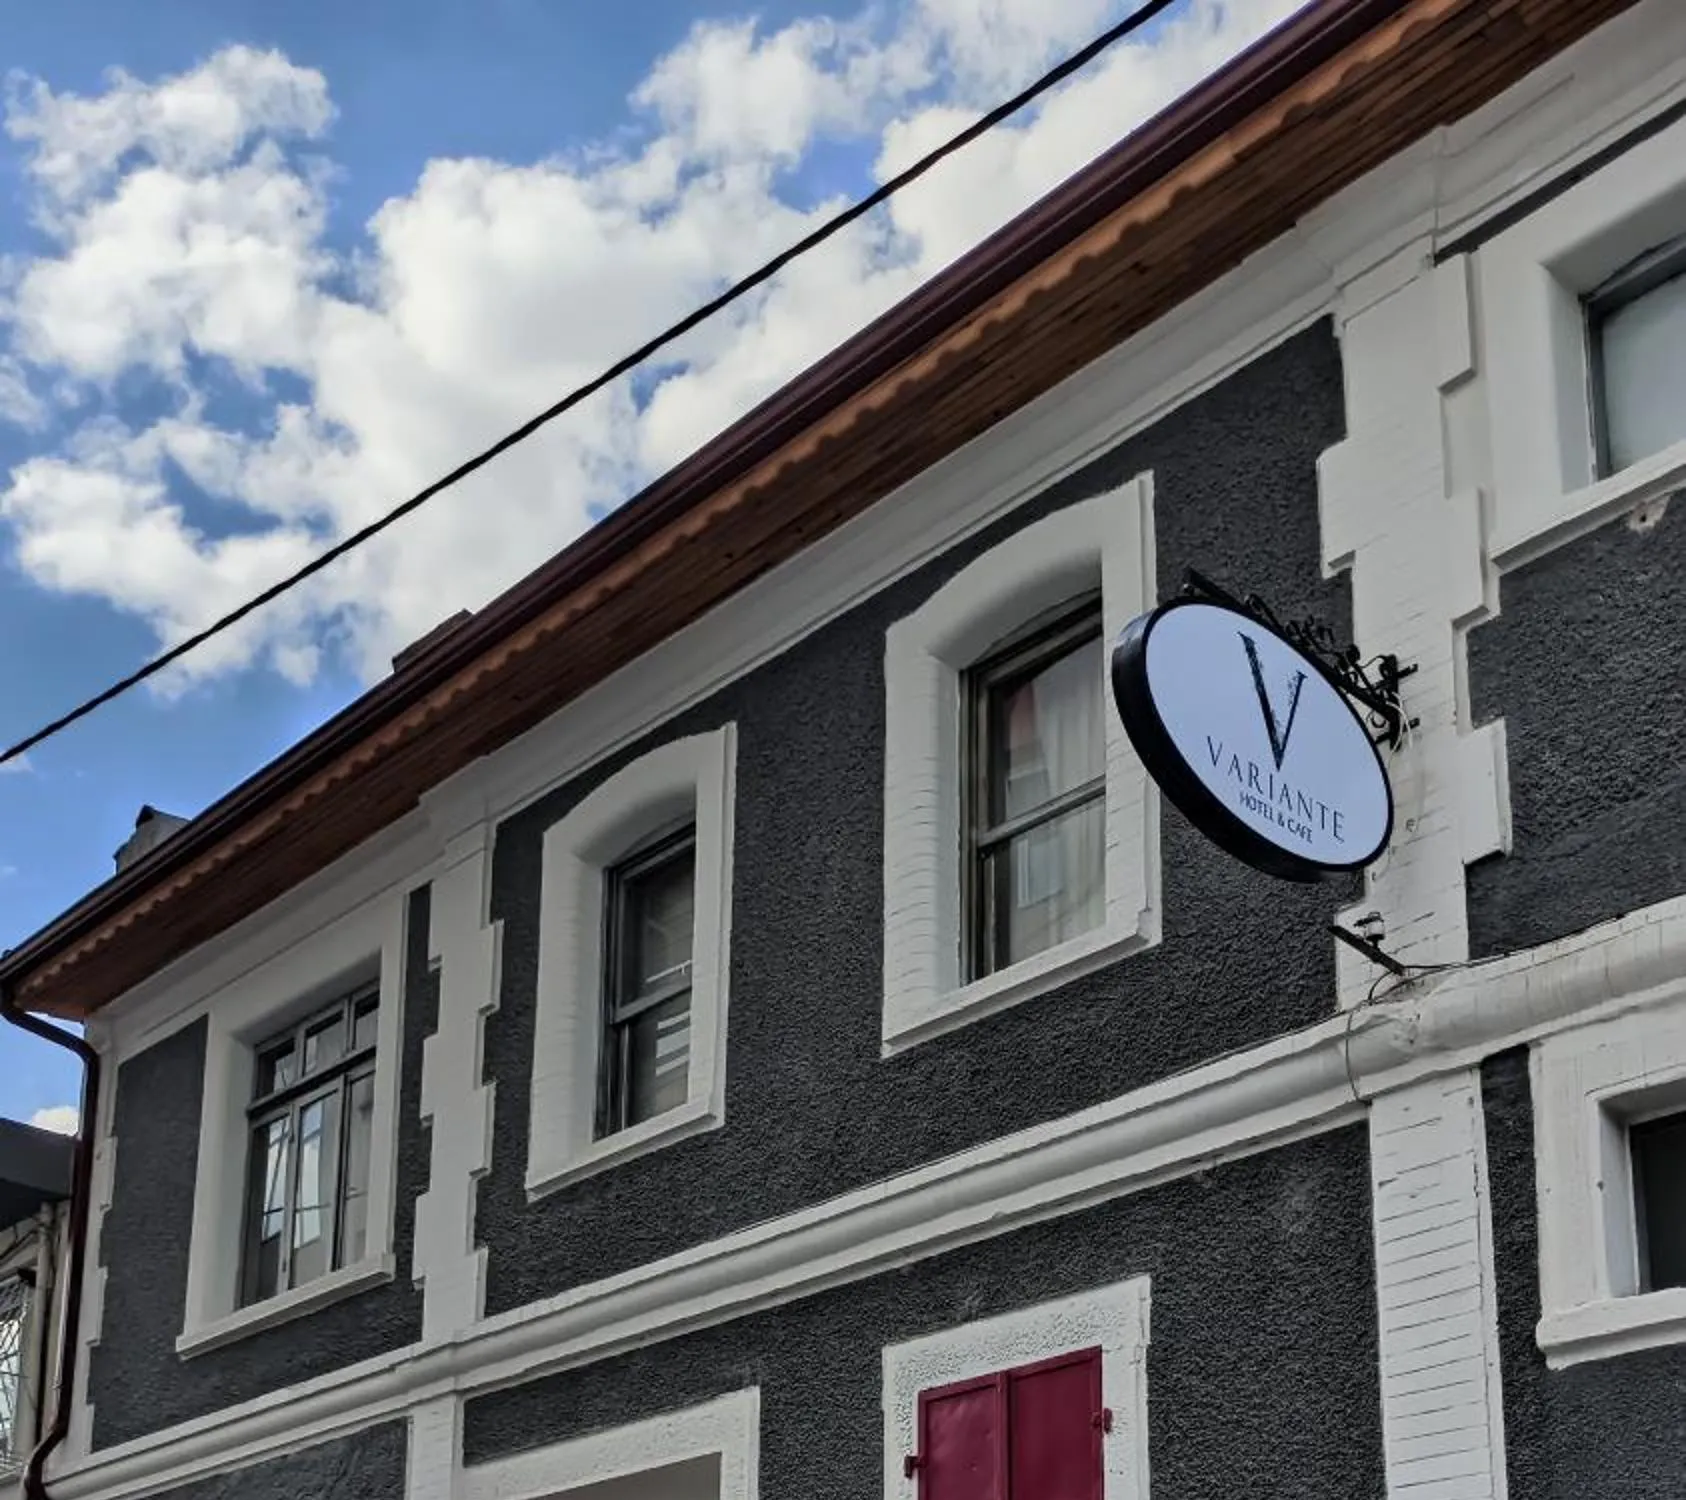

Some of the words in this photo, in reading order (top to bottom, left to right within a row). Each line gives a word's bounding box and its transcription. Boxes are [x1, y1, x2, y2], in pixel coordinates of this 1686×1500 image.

[1237, 631, 1308, 772] V
[1207, 735, 1345, 844] VARIANTE
[1240, 791, 1273, 822] HOTEL
[1277, 811, 1285, 828] &
